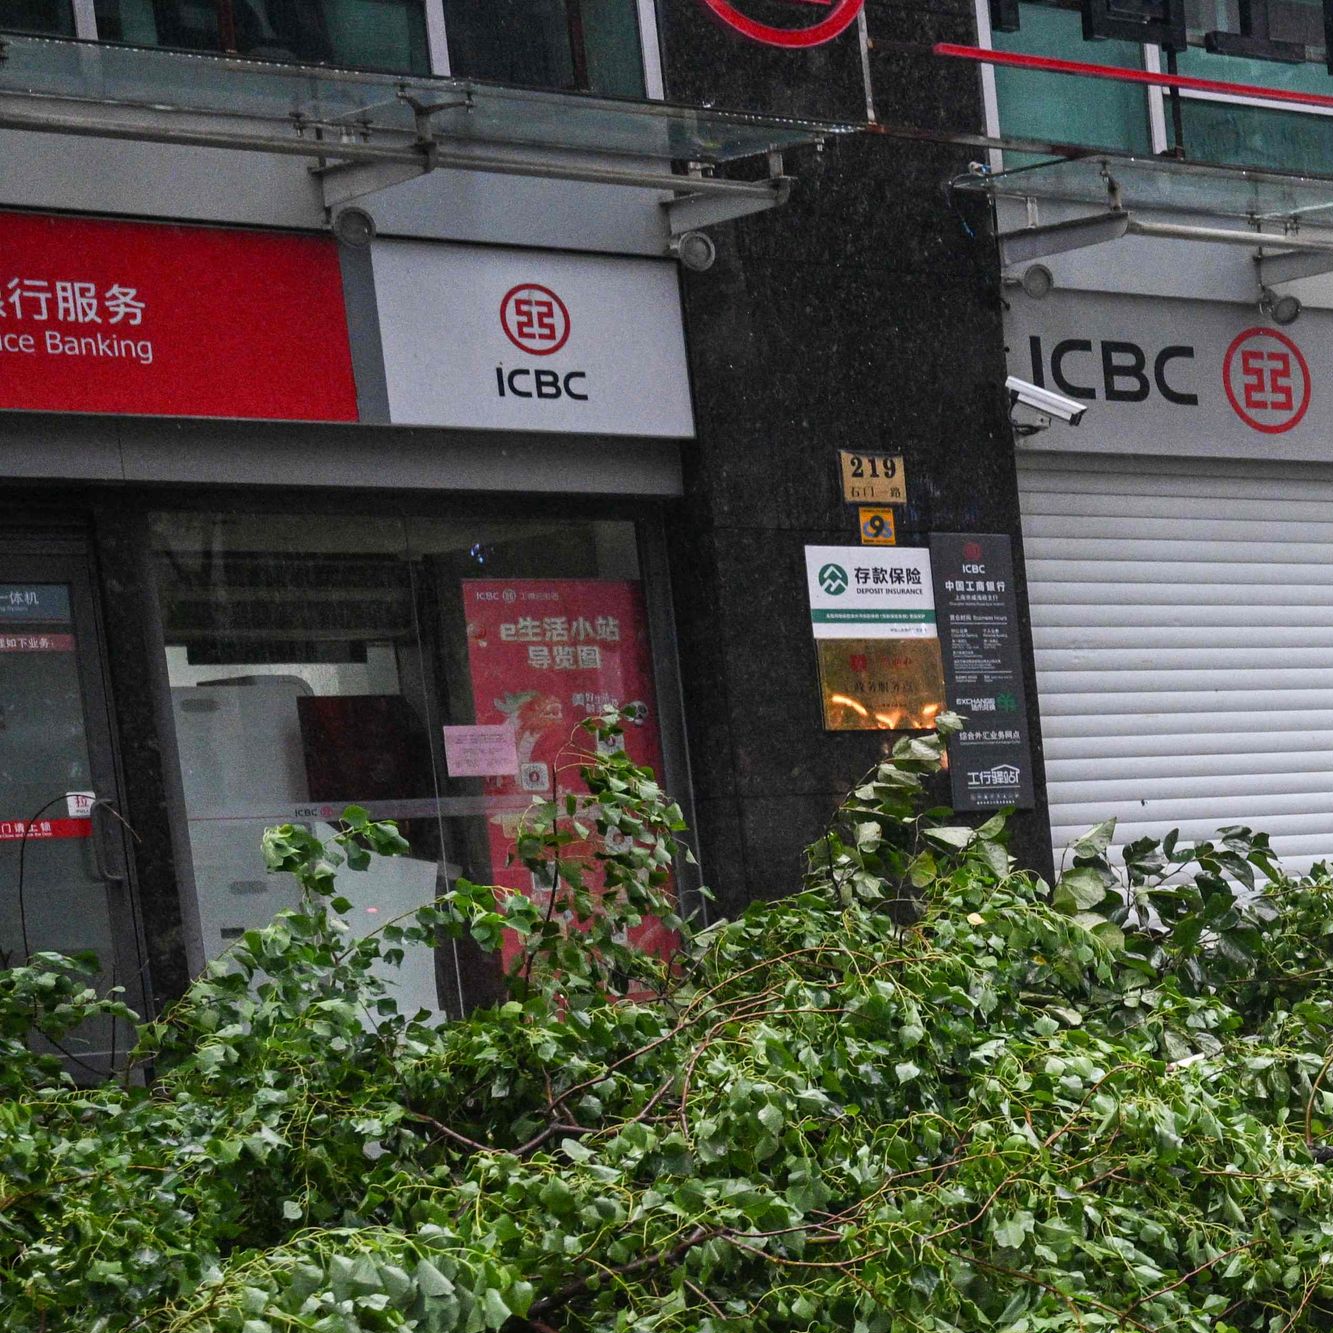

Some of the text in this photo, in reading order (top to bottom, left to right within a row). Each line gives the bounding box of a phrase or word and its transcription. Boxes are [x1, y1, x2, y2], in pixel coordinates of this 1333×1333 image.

[0, 277, 146, 326] 行服务
[45, 331, 153, 364] Banking
[1030, 336, 1198, 406] ICBC
[495, 366, 589, 401] ICBC
[850, 456, 897, 479] 219
[853, 566, 923, 585] 存款保险
[962, 564, 986, 574] ICBC
[476, 591, 499, 601] ICBC
[885, 588, 923, 596] INSURANCE
[500, 616, 620, 642] e生活小站
[528, 645, 603, 670] 导览图
[295, 808, 318, 817] ICBC
